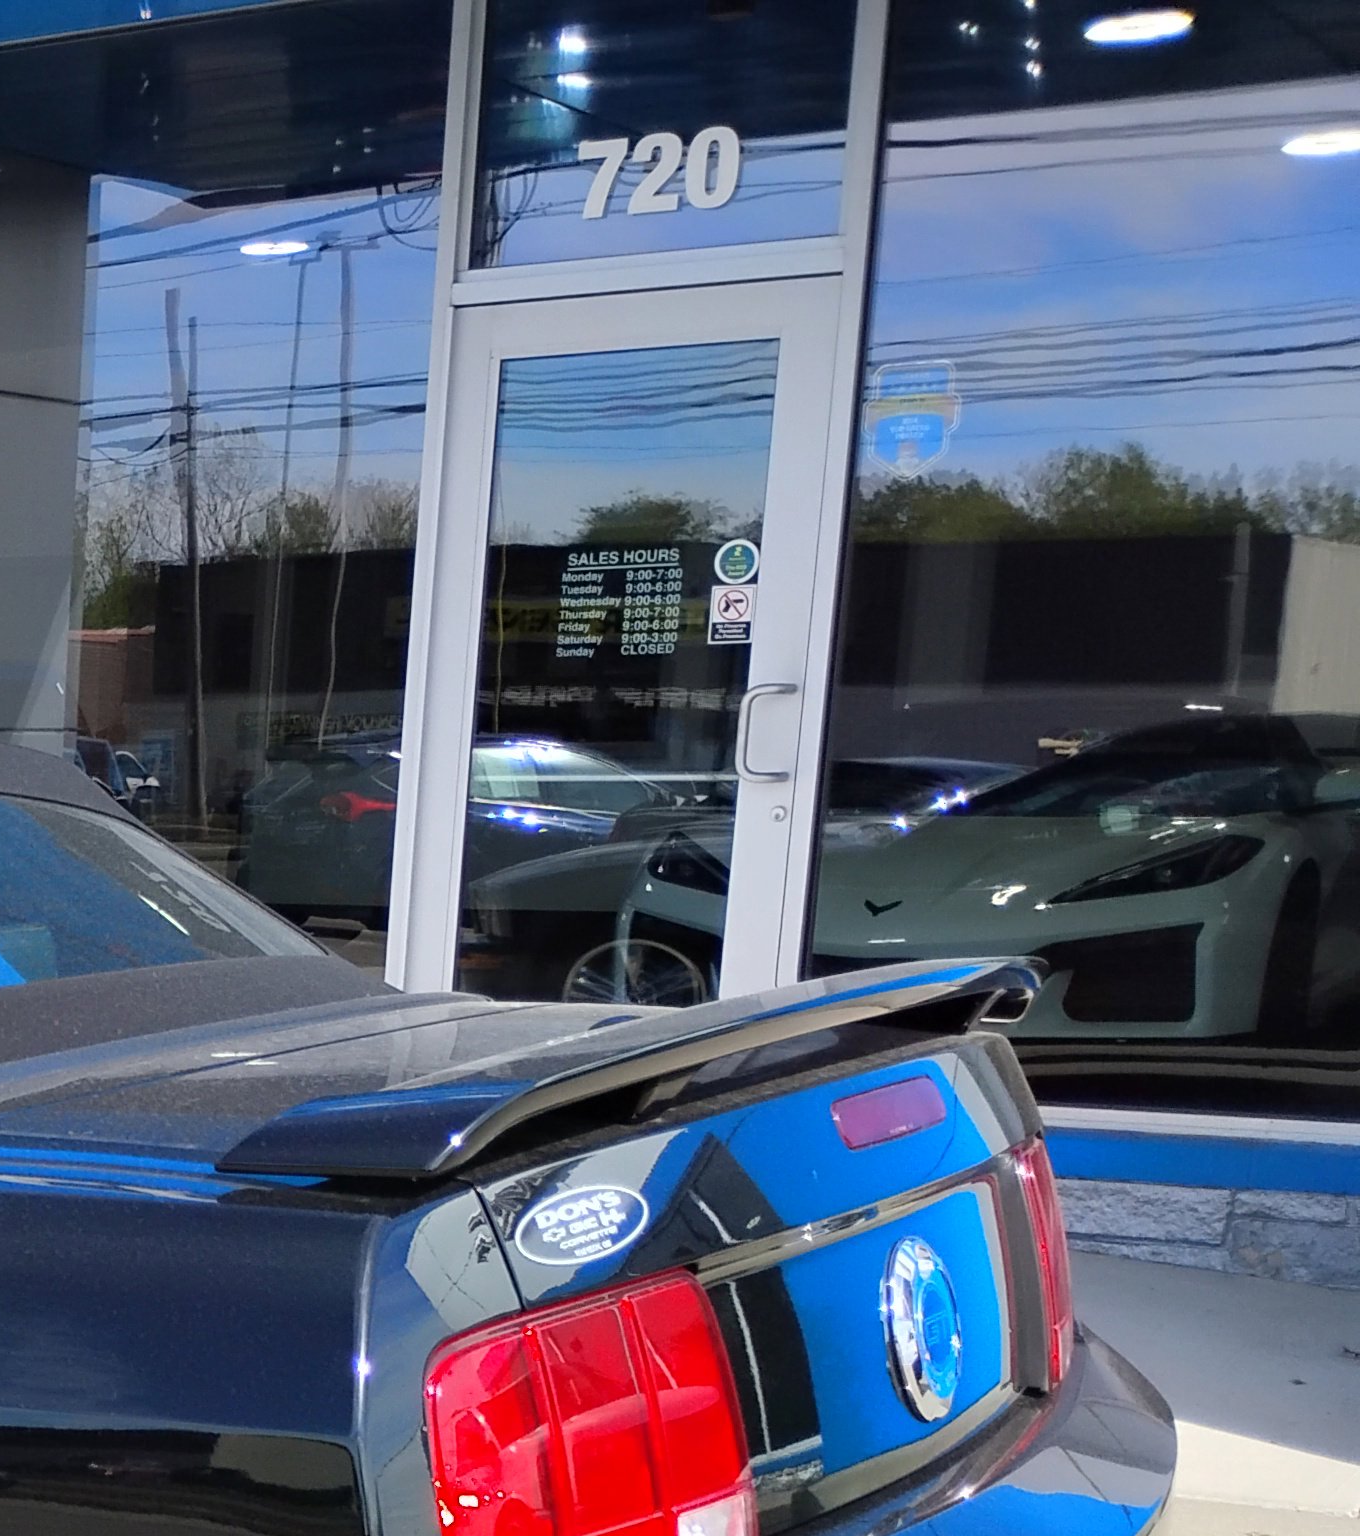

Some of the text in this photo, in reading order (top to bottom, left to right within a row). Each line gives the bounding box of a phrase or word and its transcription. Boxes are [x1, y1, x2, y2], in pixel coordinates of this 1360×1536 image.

[577, 125, 741, 219] 720
[568, 548, 680, 566] SALES HOURS
[562, 568, 683, 583] Monday 9:00-7:00
[561, 581, 682, 596] Tuesday 9:00-6:00
[560, 594, 681, 608] Wednesday 9:00-6:00
[559, 606, 680, 620] Thursday 9:00-7:00
[558, 619, 679, 633] Friday 9:00-6:00
[557, 631, 678, 646] Saturday 9:00-3:00
[556, 643, 675, 658] Sunday CLOSED
[534, 1191, 621, 1229] DON'S
